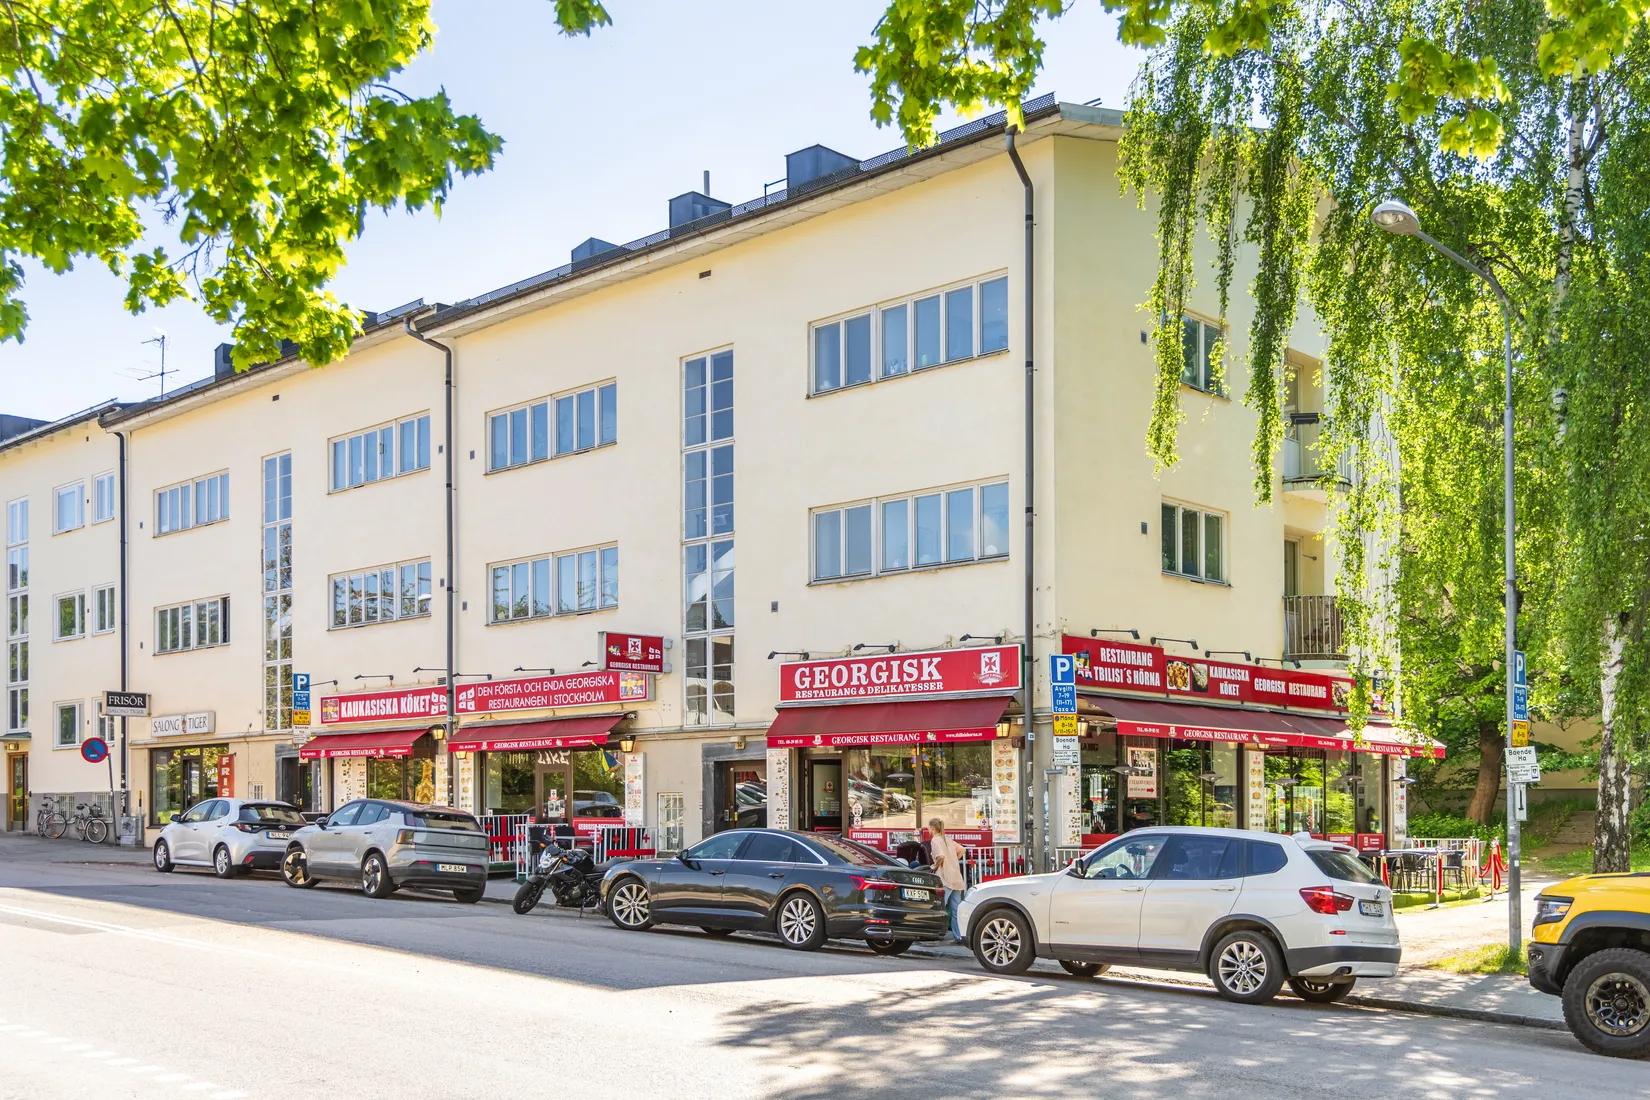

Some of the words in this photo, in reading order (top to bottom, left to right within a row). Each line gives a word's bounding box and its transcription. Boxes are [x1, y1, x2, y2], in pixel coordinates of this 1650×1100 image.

[610, 661, 632, 669] GEORGISK
[631, 663, 660, 671] RESTAURANG
[1100, 648, 1153, 667] RESTAURANG
[794, 657, 943, 689] GEORGISK
[1056, 658, 1070, 681] P
[1209, 665, 1249, 681] KAUKASISKA
[1516, 654, 1523, 681] P
[297, 675, 307, 690] P
[477, 686, 493, 697] DEN
[494, 683, 522, 695] FÖRSTA
[524, 682, 541, 693] OCH
[543, 680, 564, 691] ENDA
[566, 675, 614, 690] GEORGISKA
[1133, 669, 1161, 687] HÖRNA
[795, 687, 857, 699] RESTAURANG
[858, 687, 866, 695] &
[867, 681, 944, 694] DELIKATESSER
[1219, 682, 1240, 696] KÖKET
[1254, 678, 1286, 694] GEORGISK
[1288, 683, 1326, 699] RESTAURANG
[108, 695, 144, 706] FRISÖR
[341, 698, 398, 718] KAUKASISKA
[400, 694, 431, 714] KÖKET
[488, 695, 548, 709] RESTAURANGEN
[549, 695, 552, 705] I
[554, 691, 605, 704] STOCKHOLM
[153, 719, 180, 733] SALONG
[188, 716, 207, 730] TIGER
[831, 735, 869, 744] GEORGISK
[869, 732, 920, 743] RESTAURANG
[1184, 729, 1214, 740] GEORGISK
[1213, 731, 1249, 741] RESTAURANG
[494, 741, 519, 749] GEORGISK
[519, 739, 553, 748] RESTAURANG
[1375, 745, 1402, 753] RESTAURANG
